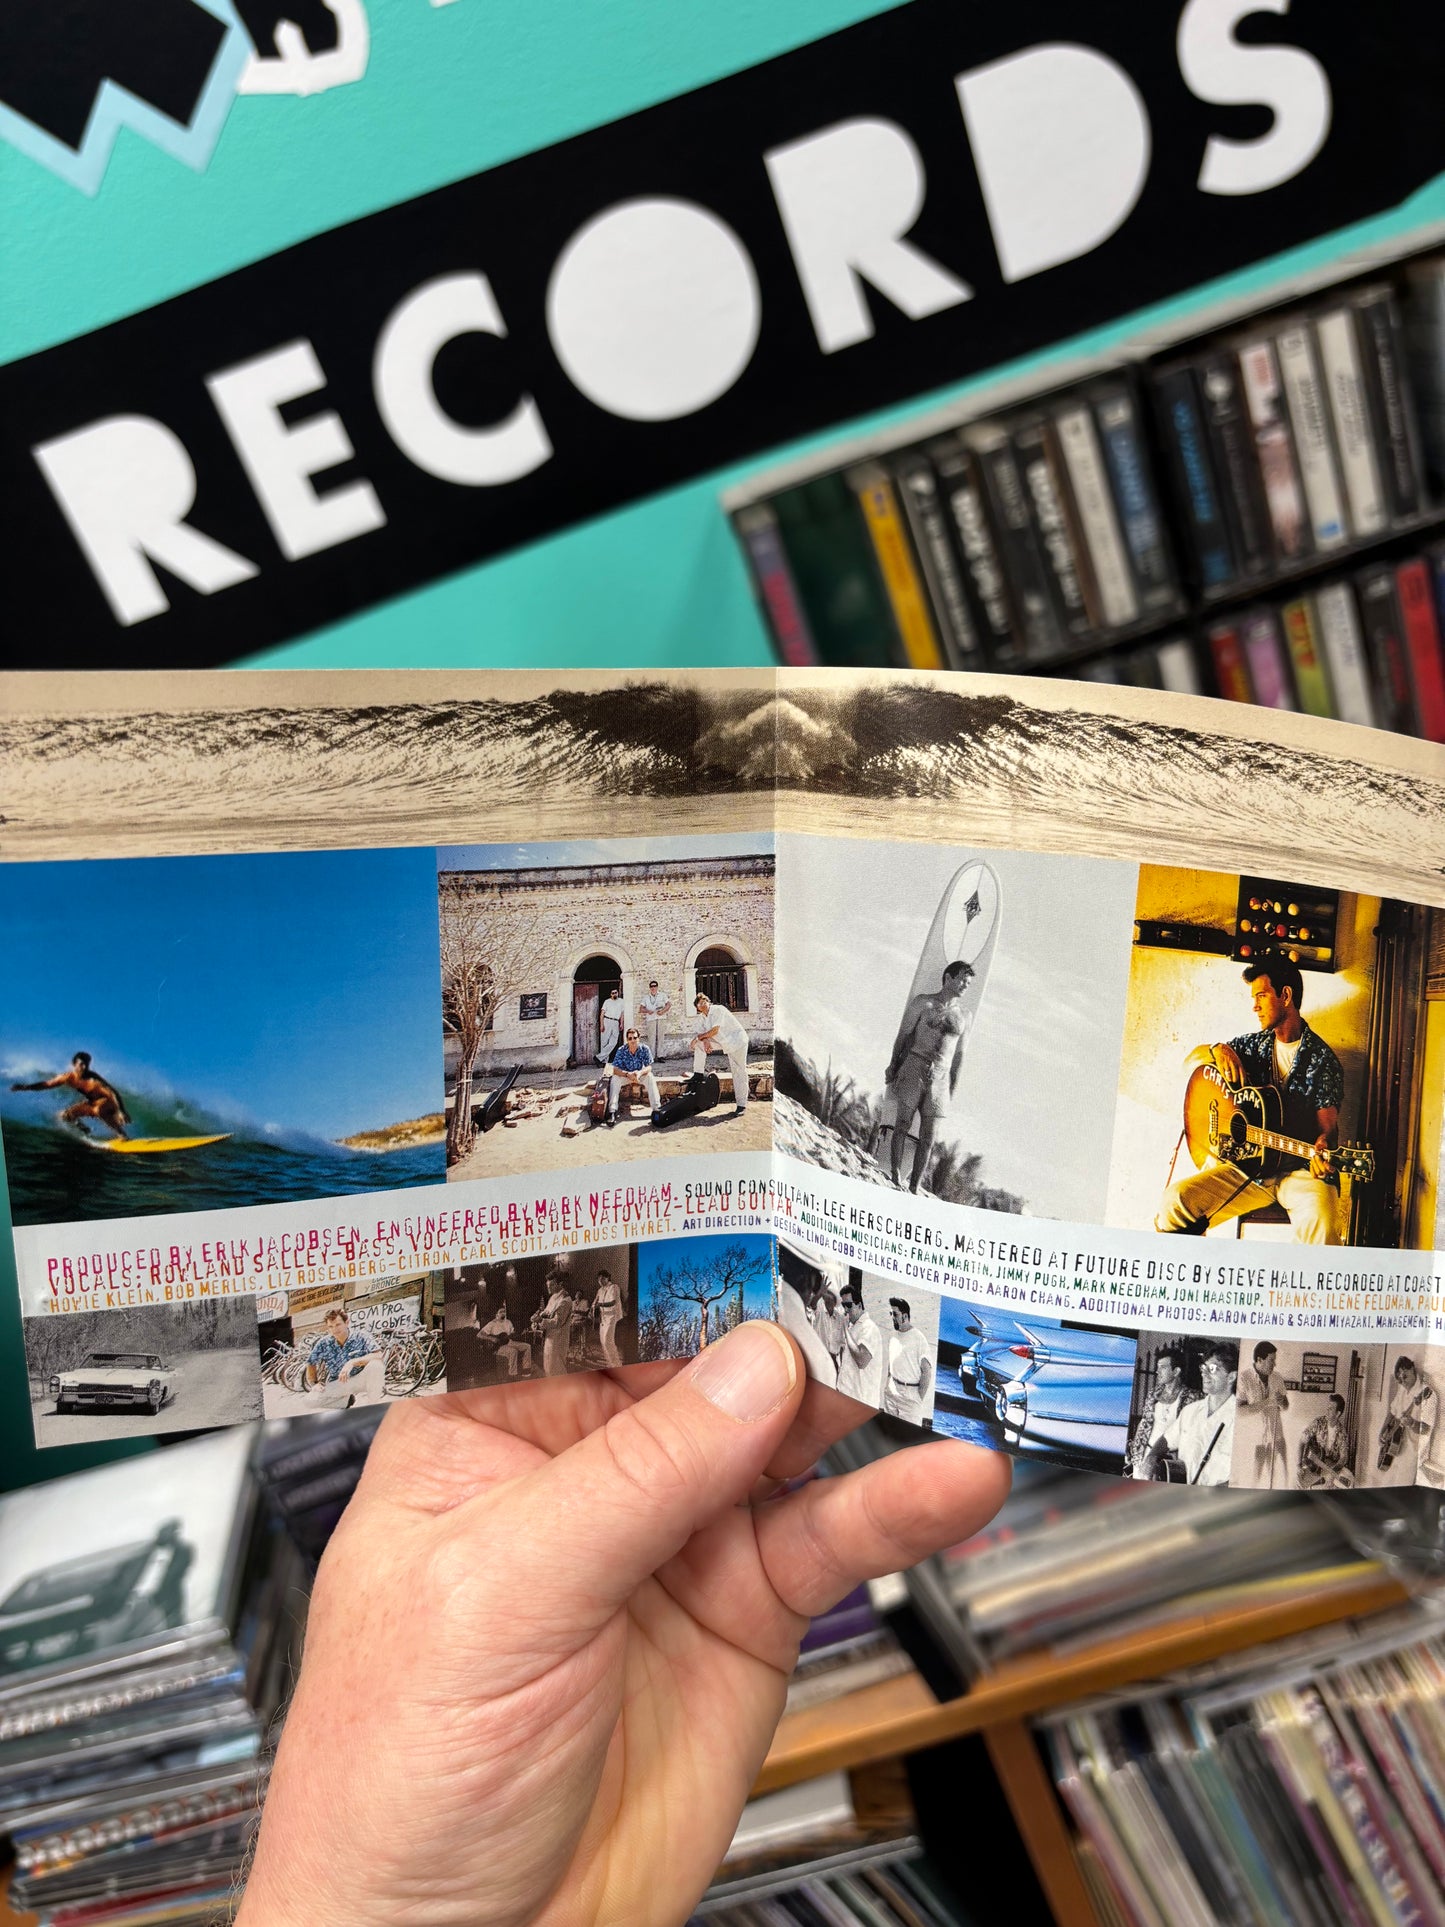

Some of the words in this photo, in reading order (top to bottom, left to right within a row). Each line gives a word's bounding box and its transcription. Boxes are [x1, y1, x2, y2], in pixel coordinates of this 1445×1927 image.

[32, 0, 1333, 627] RECORDS
[1203, 1065, 1230, 1099] CHRIS
[1233, 1089, 1261, 1109] ISAAK
[47, 1248, 161, 1278] PRODUCED
[170, 1245, 193, 1267] BY
[202, 1239, 250, 1263] ERIK
[258, 1226, 369, 1255] JACOBSEN.
[376, 1205, 500, 1241] ENGINEERED
[508, 1201, 529, 1222] BY
[535, 1195, 582, 1218] MARK
[589, 1182, 679, 1210] NEEDHAM.
[685, 1180, 732, 1199] SOUND
[738, 1179, 820, 1211] CONSULTANT:
[823, 1198, 845, 1221] LEE
[850, 1207, 949, 1250] HERSCHBERG.
[954, 1234, 1042, 1266] MASTERED
[1049, 1251, 1068, 1270] AT
[1074, 1253, 1141, 1278] FUTURE
[1147, 1260, 1187, 1282] DISC
[1193, 1265, 1212, 1284] BY
[1217, 1267, 1266, 1288] STEVE
[1270, 1269, 1311, 1291] HALL.
[1317, 1271, 1384, 1292] RECORDED
[1387, 1275, 1401, 1292] AT
[1404, 1275, 1441, 1294] COAST
[50, 1293, 100, 1313] HOWIE
[106, 1288, 160, 1307] KLEIN,
[165, 1282, 195, 1301] BOB
[267, 1271, 292, 1289] LIZ
[460, 1244, 497, 1261] CARL
[502, 1237, 548, 1255] SCOTT,
[552, 1231, 578, 1247] AND
[584, 1226, 618, 1243] RUSS
[683, 1217, 702, 1230] ART
[705, 1215, 761, 1229] DIRECTION
[774, 1216, 805, 1239] DESIGN:
[806, 1229, 830, 1248] LINDA
[833, 1239, 855, 1257] COBB
[857, 1250, 903, 1273] STALKER.
[906, 1262, 940, 1284] COVER
[943, 1272, 983, 1293] PHOTO:
[986, 1282, 1026, 1301] AARON
[1030, 1290, 1075, 1310] CHANG.
[1079, 1296, 1153, 1318] ADDITIONAL
[1157, 1305, 1207, 1322] PHOTOS:
[1210, 1309, 1247, 1324] AARON
[1250, 1312, 1285, 1326] CHANG
[1287, 1313, 1294, 1326] &
[1297, 1313, 1327, 1328] SAORI
[1376, 1315, 1431, 1328] MANAGEMENT:
[151, 1255, 244, 1286] ROWLAND
[500, 1211, 584, 1240] HERSHEL
[738, 1192, 798, 1220] GUITAR.
[801, 1211, 849, 1240] ADDITIONAL
[851, 1229, 908, 1257] MUSICIANS:
[910, 1247, 945, 1266] FRANK
[947, 1255, 993, 1278] MARTIN,
[996, 1265, 1030, 1284] JIMMY
[1034, 1272, 1070, 1290] PUGH,
[1073, 1277, 1106, 1293] MARK
[1110, 1282, 1170, 1301] NEEDHAM,
[1173, 1288, 1199, 1302] JONI
[1203, 1290, 1264, 1307] HAASTRUP.
[1269, 1291, 1322, 1308] THANKS:
[1326, 1293, 1360, 1310] ILENE
